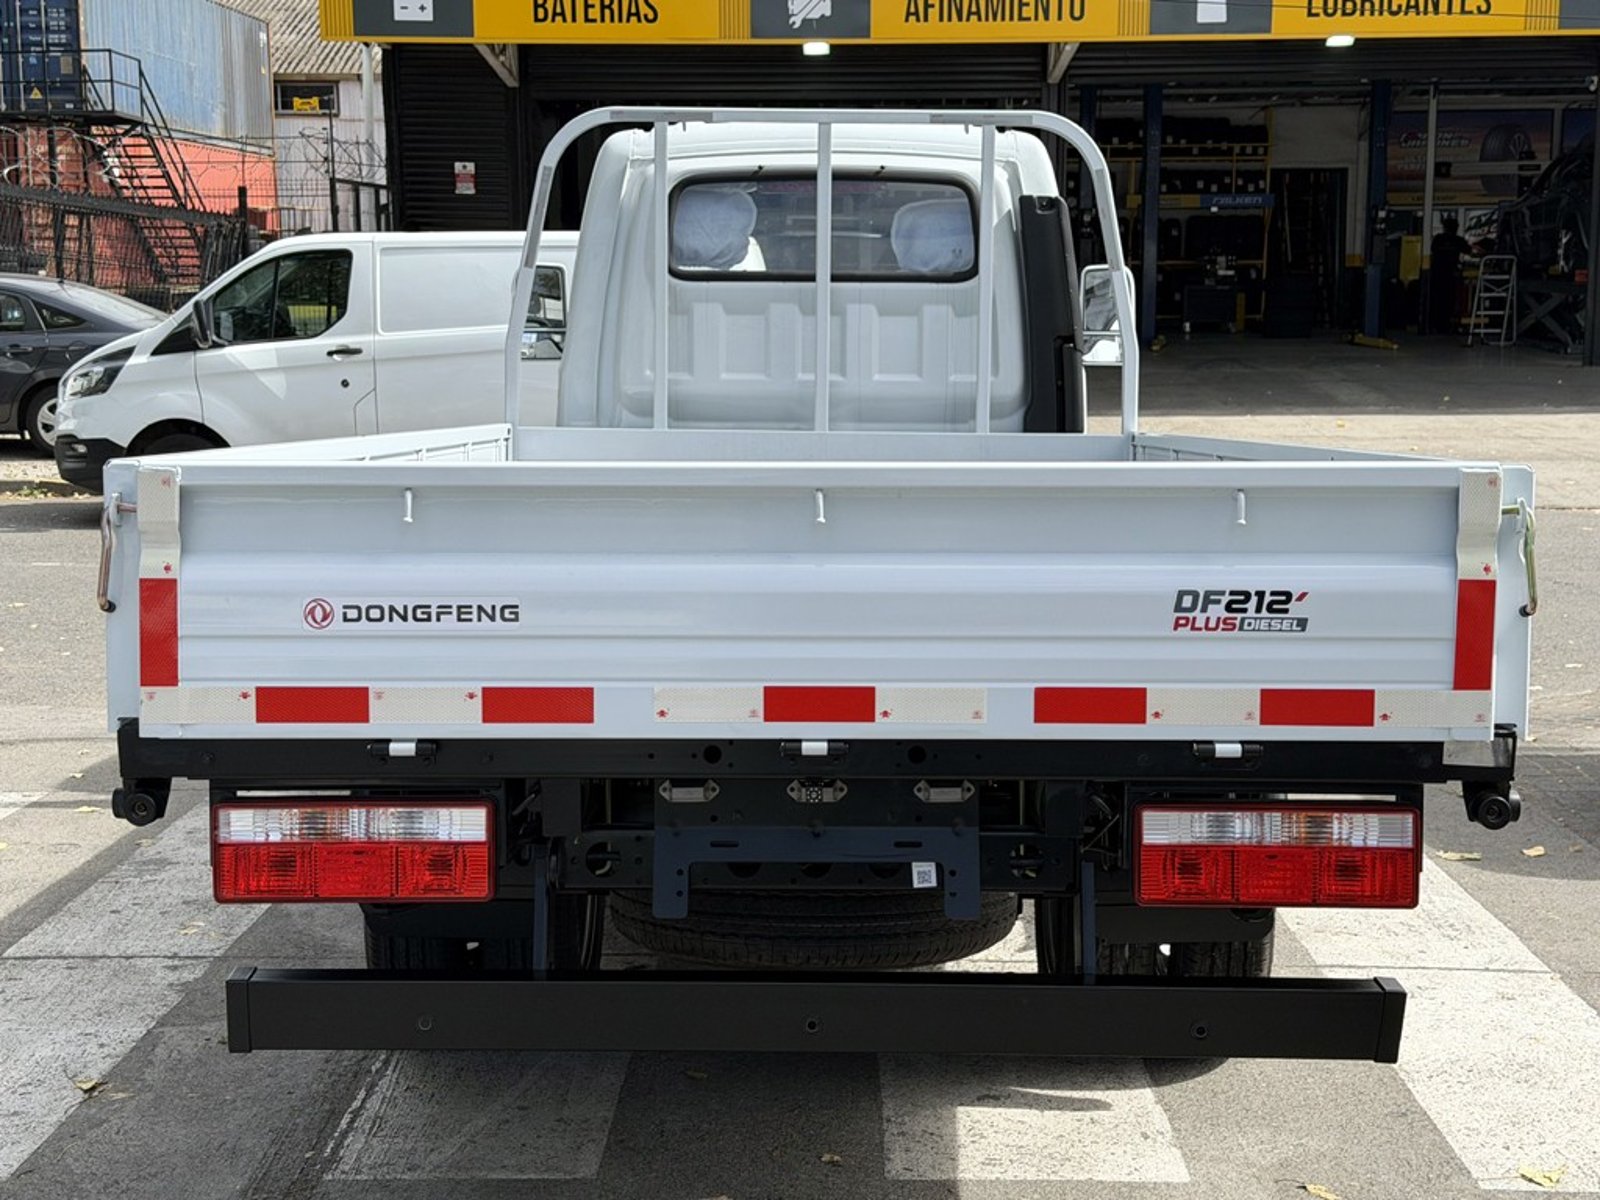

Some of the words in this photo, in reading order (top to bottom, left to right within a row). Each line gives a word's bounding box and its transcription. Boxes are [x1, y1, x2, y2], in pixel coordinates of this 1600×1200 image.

[533, 0, 659, 24] BATERIAS
[904, 0, 1085, 23] AFINAMIENTO
[342, 604, 519, 622] DONGFENG
[1173, 589, 1293, 614] DF212
[1173, 616, 1238, 632] PLUS
[1243, 618, 1303, 631] DIESEL
